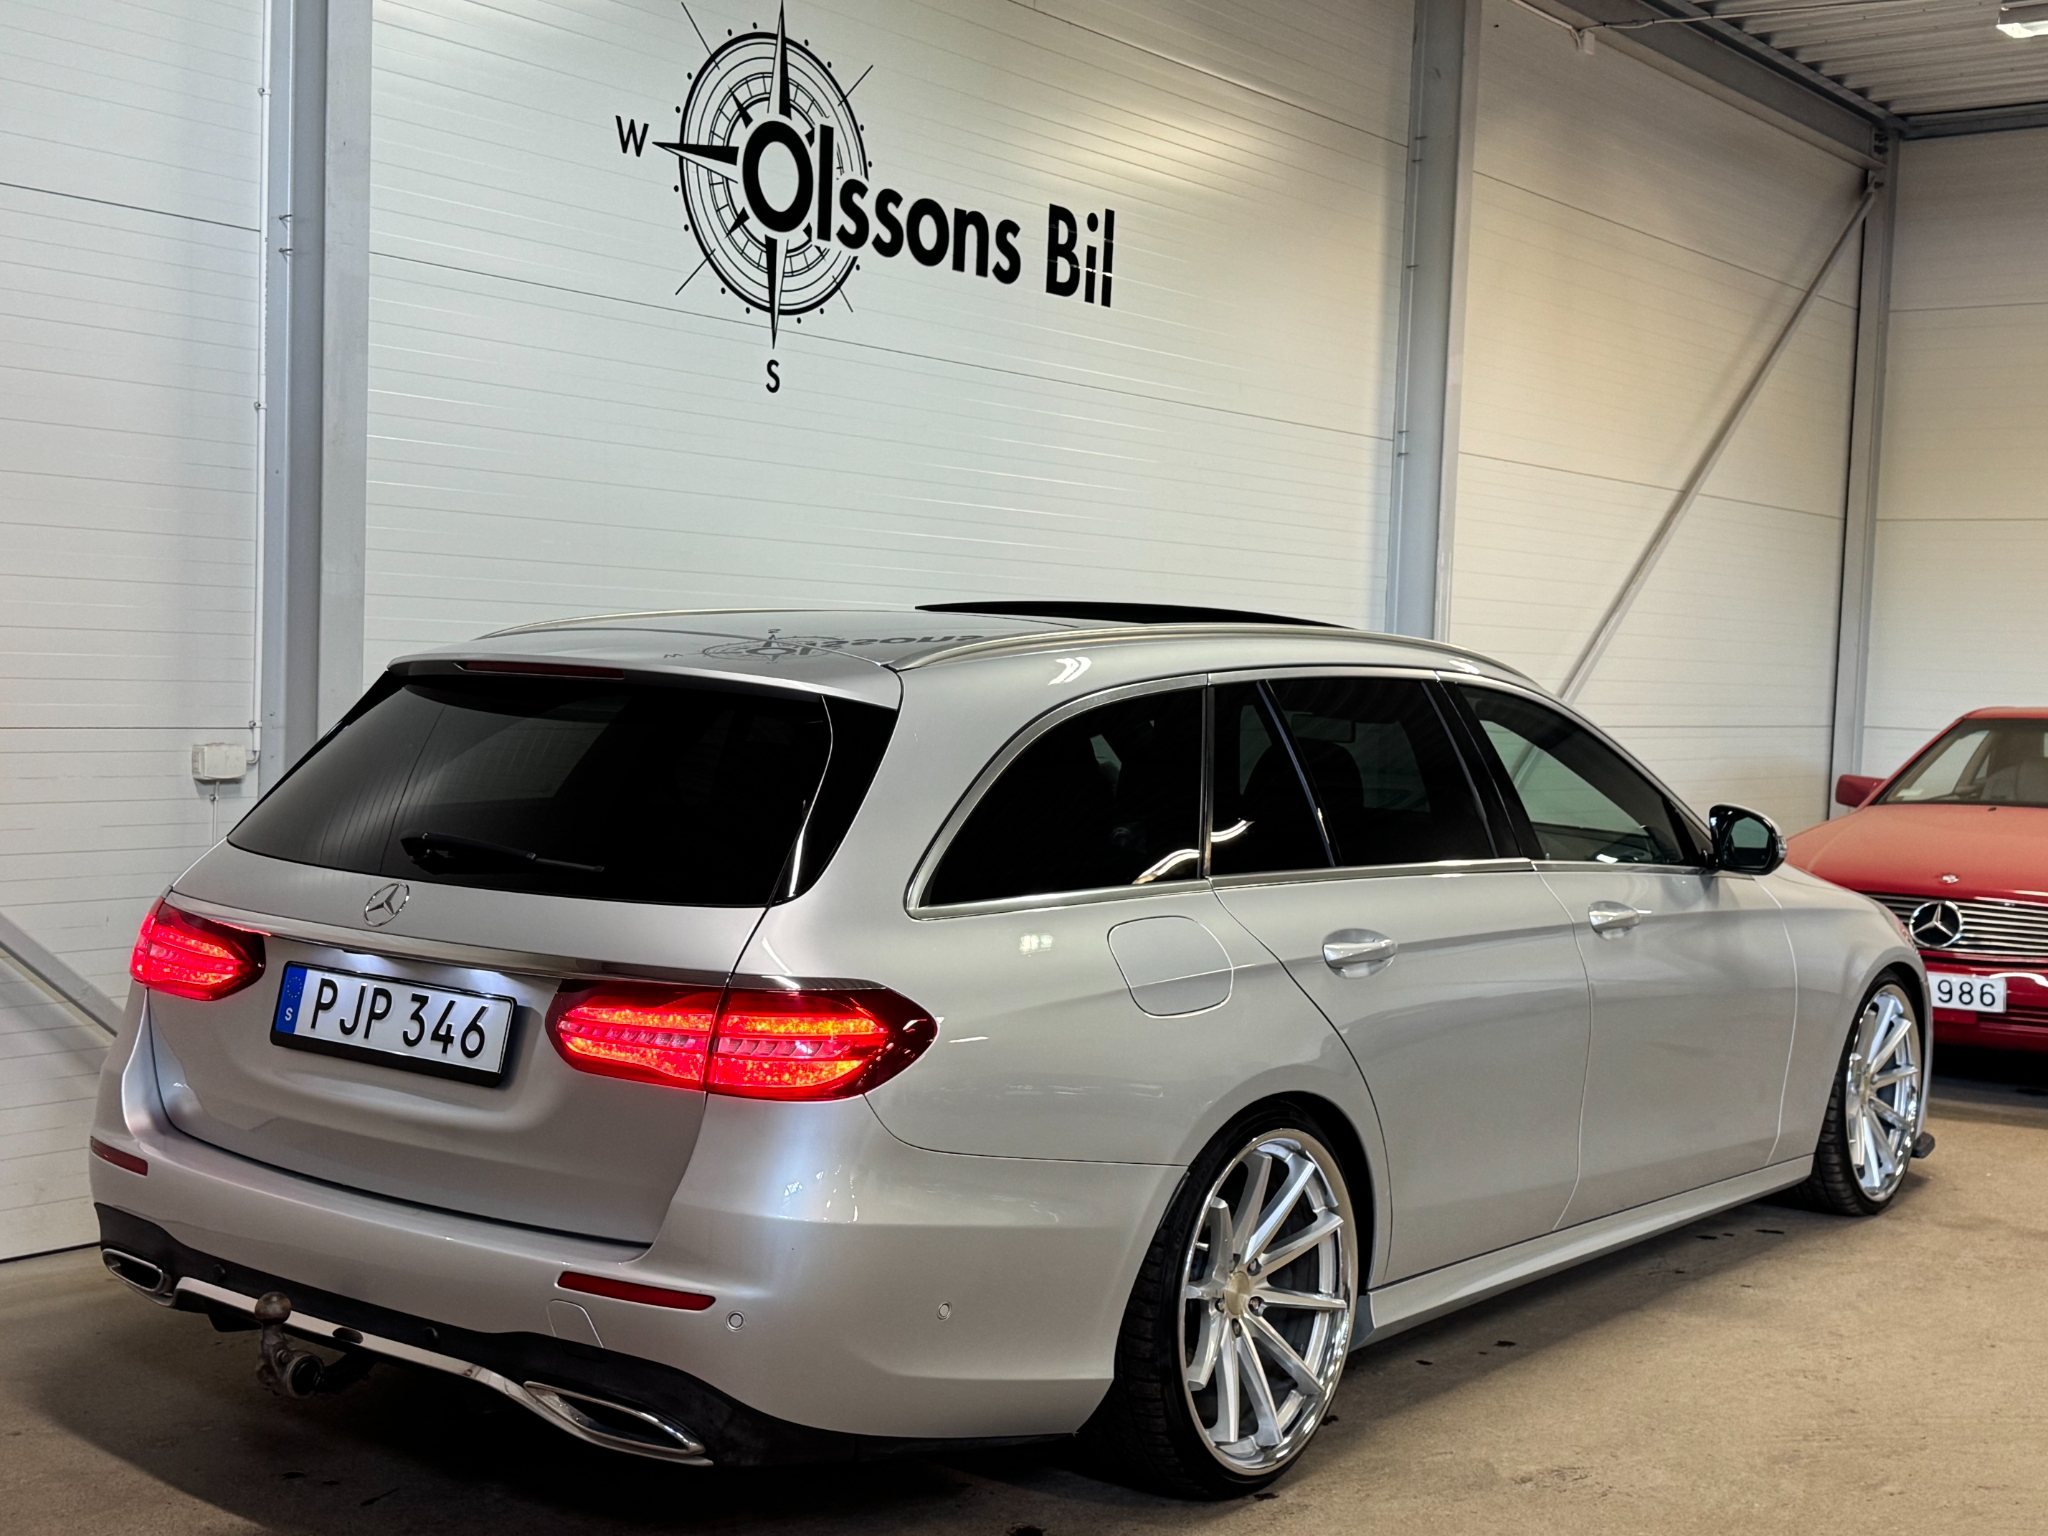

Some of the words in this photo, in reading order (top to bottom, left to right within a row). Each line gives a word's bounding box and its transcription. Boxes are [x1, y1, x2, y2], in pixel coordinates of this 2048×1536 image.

[616, 116, 650, 158] W
[742, 120, 1022, 284] Olssons
[1046, 204, 1115, 307] Bil
[766, 360, 780, 393] S
[1937, 979, 1996, 1007] 986
[284, 1007, 293, 1021] S
[310, 978, 393, 1040] PJP
[402, 993, 489, 1059] 346
